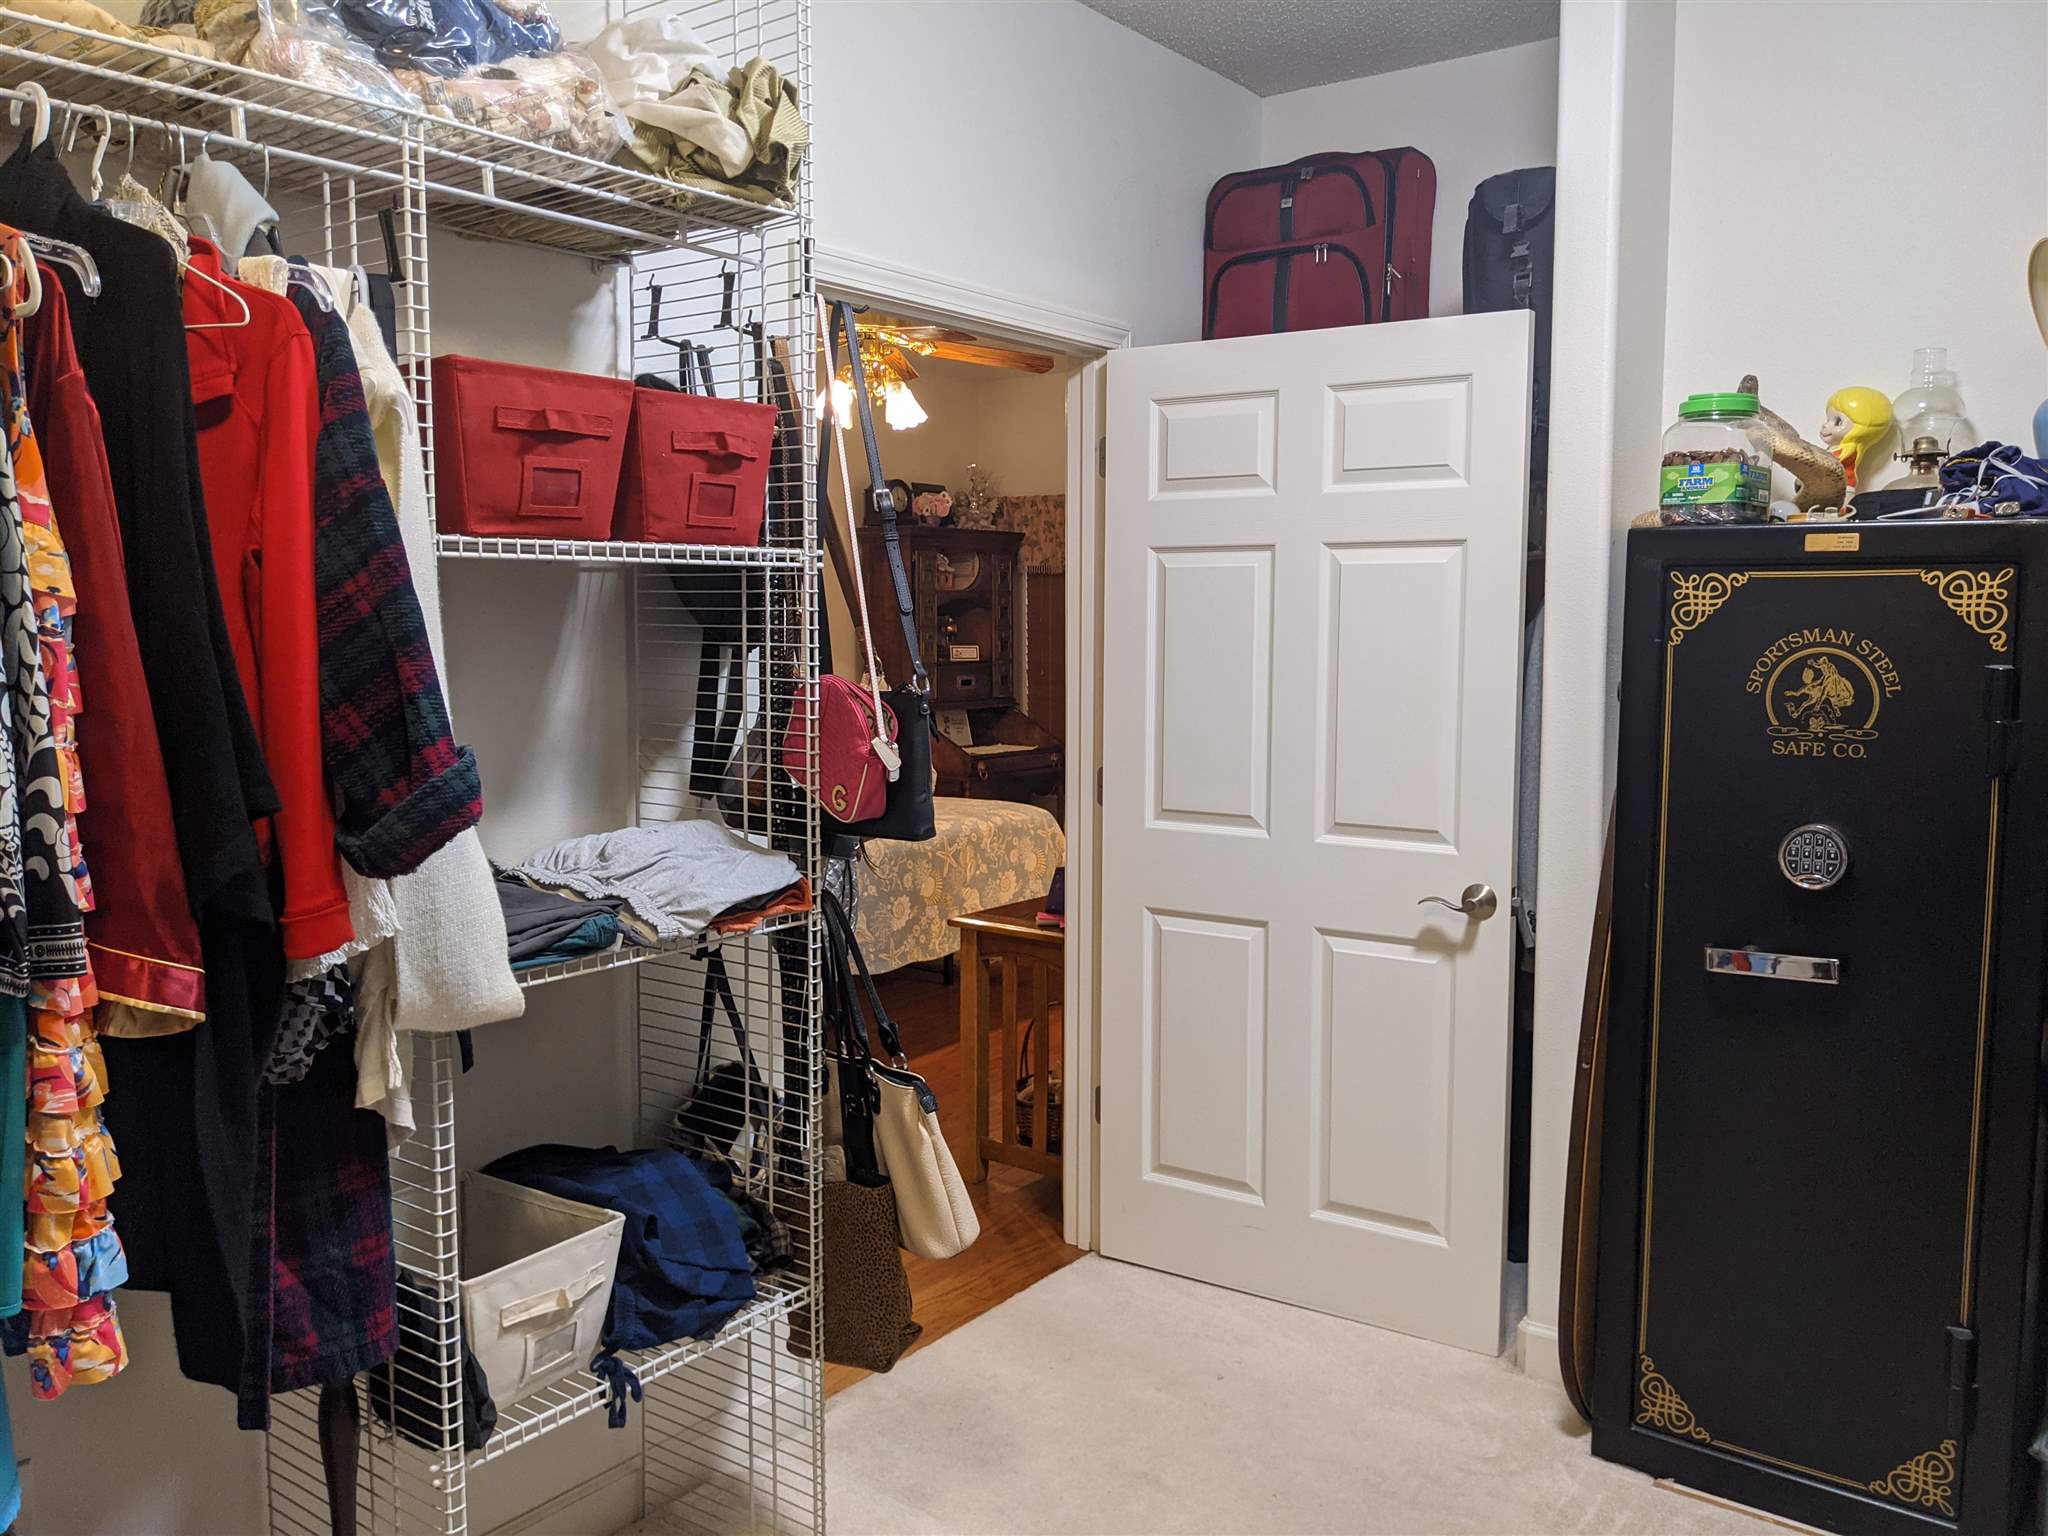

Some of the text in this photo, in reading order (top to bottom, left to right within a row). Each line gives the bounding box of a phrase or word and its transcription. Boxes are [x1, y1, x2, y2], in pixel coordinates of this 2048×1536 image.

[1679, 477, 1713, 486] FARM
[1746, 627, 1902, 698] SPORTSMAN STEEL
[1771, 740, 1867, 759] SAFE CO.
[831, 784, 848, 812] G
